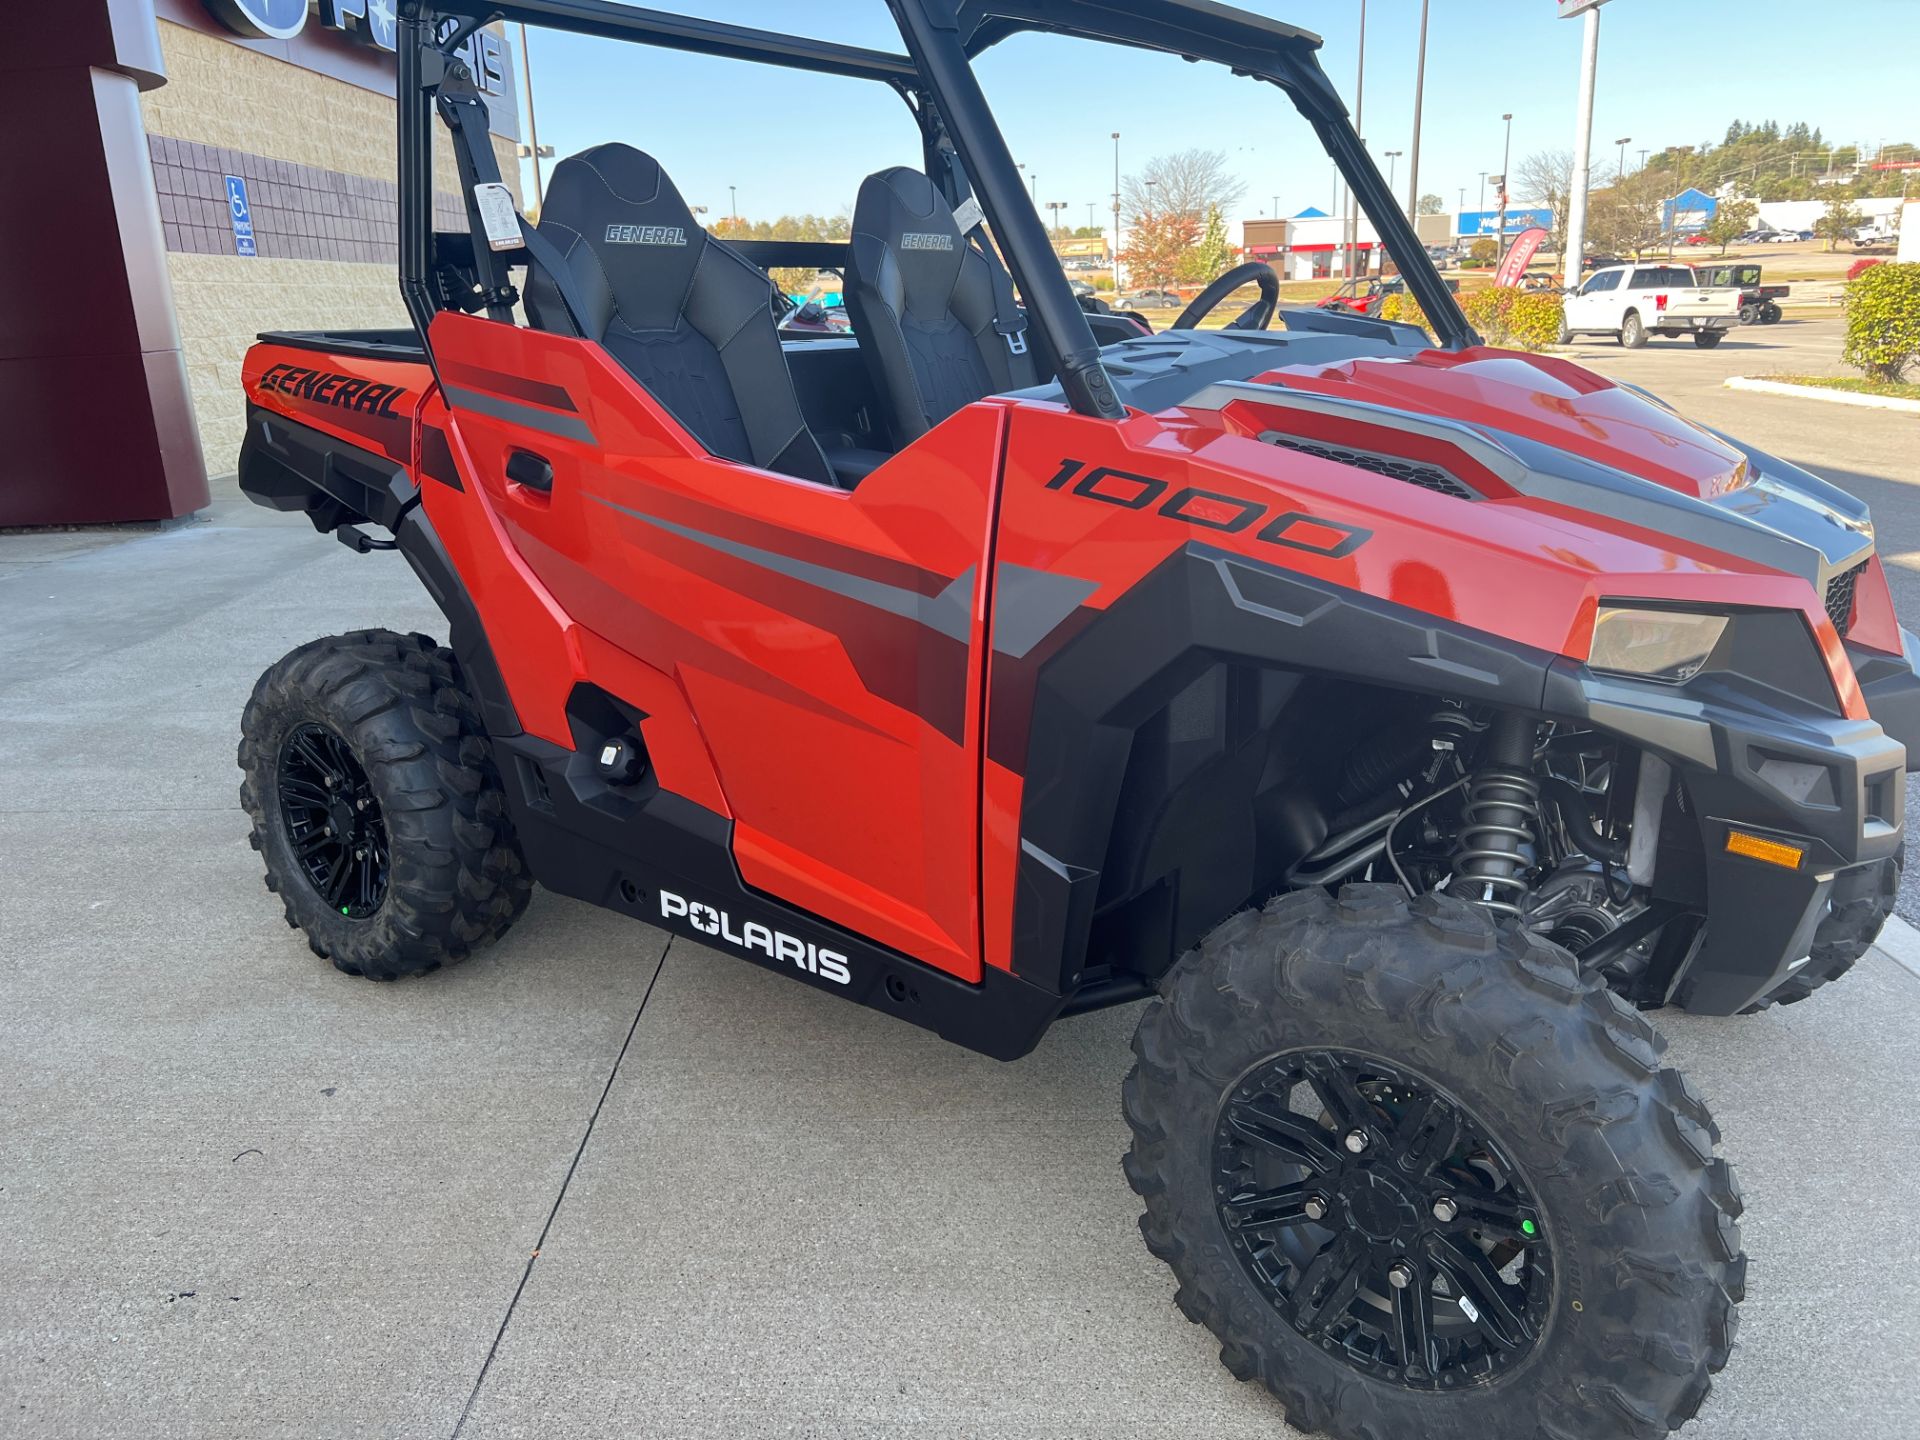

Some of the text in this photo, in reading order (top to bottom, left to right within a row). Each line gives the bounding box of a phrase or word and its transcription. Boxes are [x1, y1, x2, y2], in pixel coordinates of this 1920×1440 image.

[605, 225, 686, 245] GENERAL
[901, 234, 953, 250] GENERAL
[259, 363, 408, 420] GENERAL
[1044, 458, 1374, 559] 1000
[660, 889, 851, 985] POLARIS
